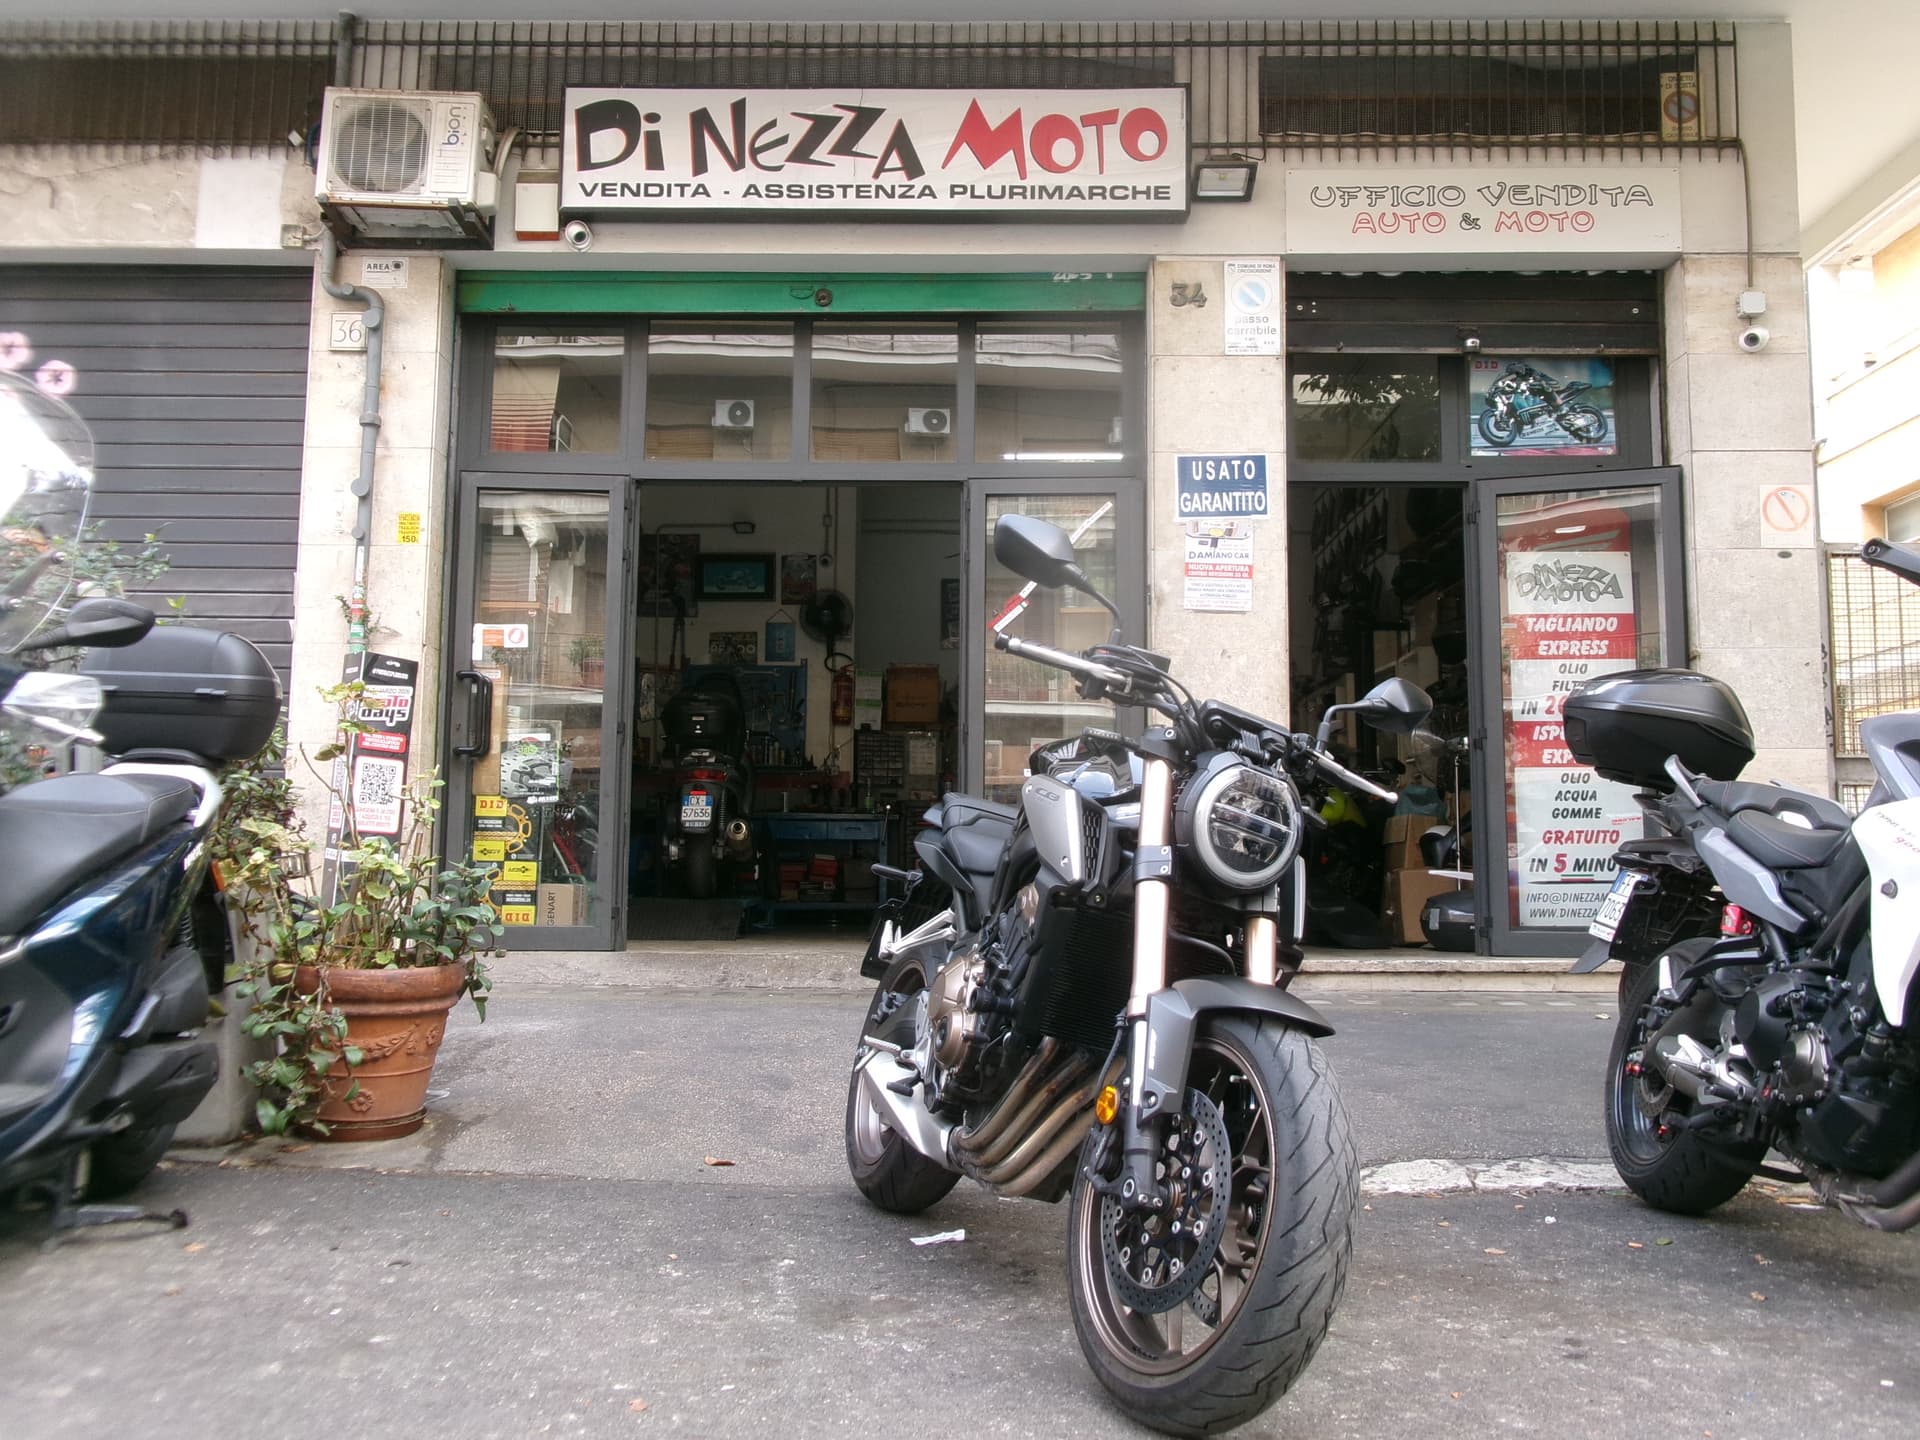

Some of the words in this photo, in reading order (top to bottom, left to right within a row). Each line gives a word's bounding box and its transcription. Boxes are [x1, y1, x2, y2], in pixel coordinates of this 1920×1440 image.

[941, 97, 1167, 180] MOTO
[579, 182, 711, 198] VENDITA
[741, 183, 937, 200] ASSISTENZA
[949, 184, 1171, 201] PLURIMARCHE
[1310, 185, 1466, 208] UFFICIO
[1477, 181, 1654, 207] VENDITA
[1352, 212, 1446, 234] AUTO
[1459, 213, 1481, 231] &
[1494, 211, 1595, 233] MOTO
[1170, 281, 1208, 308] 34
[1235, 316, 1269, 325] passo
[333, 319, 363, 343] 36
[1227, 326, 1277, 335] carrabile
[1192, 460, 1256, 481] USATO
[1180, 491, 1266, 513] GARANTITO
[402, 535, 416, 543] 150
[1188, 551, 1233, 559] DAMIANO
[1234, 552, 1250, 560] CAR
[1525, 617, 1618, 633] TAGLIANDO
[1537, 640, 1609, 656] EXPRESS
[1558, 663, 1588, 674] OLIO
[1521, 701, 1538, 715] IN
[1542, 748, 1577, 764] EXP
[1561, 773, 1590, 784] OLIO
[1555, 790, 1597, 802] ACQUA
[480, 800, 504, 809] DID
[1552, 808, 1603, 819] GOMME
[1542, 830, 1621, 845] GRATUITO
[1529, 858, 1548, 873] IN
[1553, 853, 1568, 873] 5
[1573, 858, 1616, 873] MINU
[1529, 908, 1599, 918] WWW.DINEZZA
